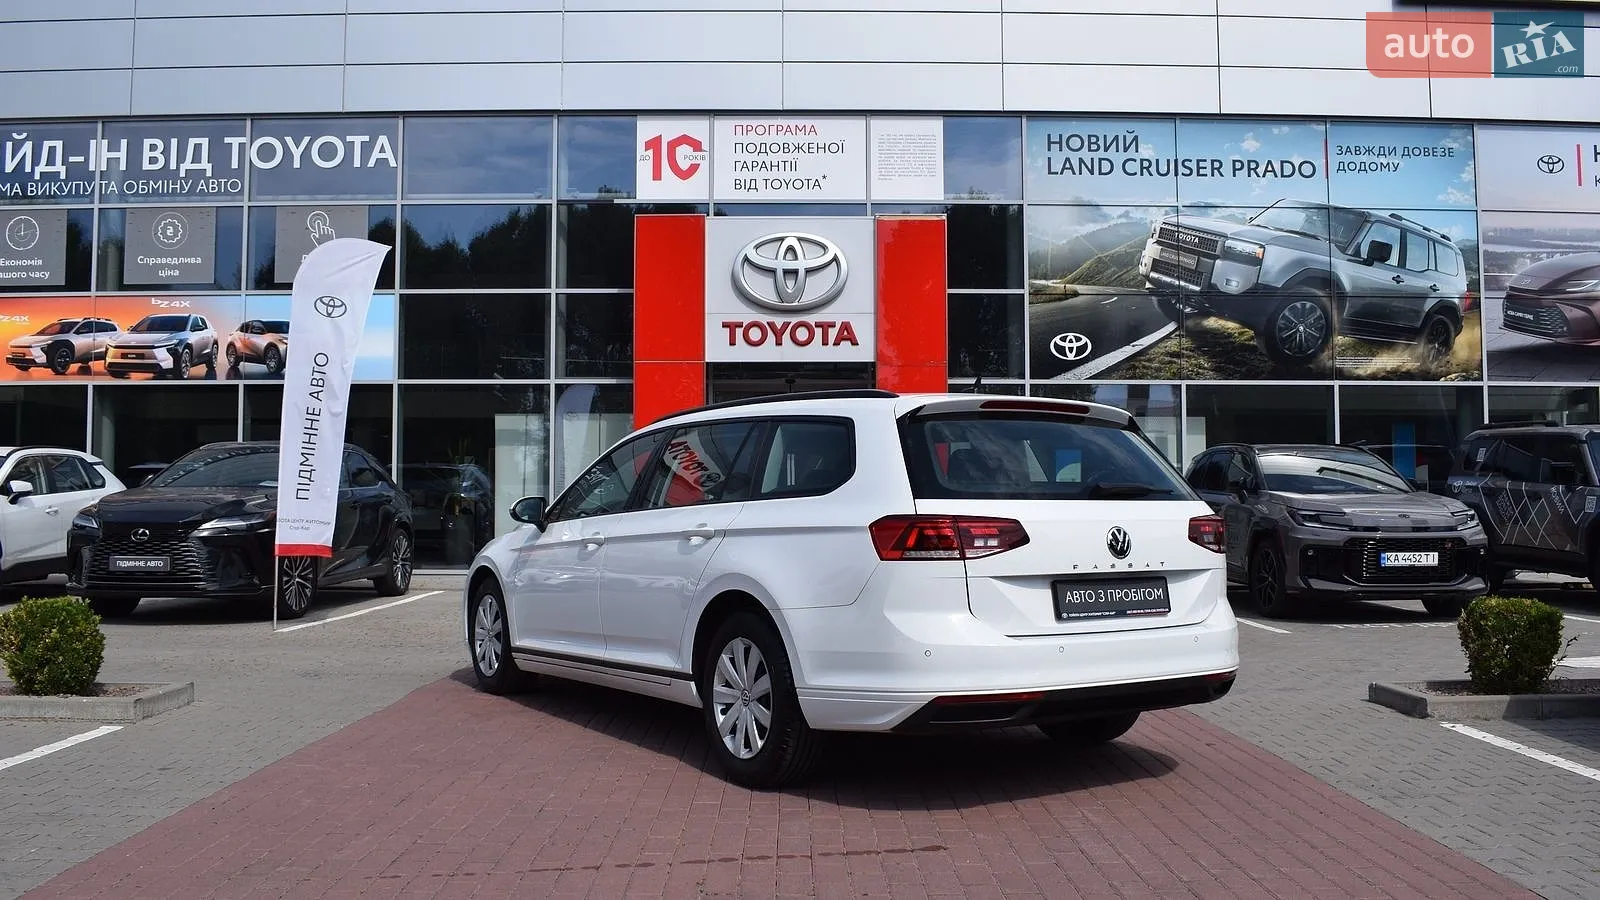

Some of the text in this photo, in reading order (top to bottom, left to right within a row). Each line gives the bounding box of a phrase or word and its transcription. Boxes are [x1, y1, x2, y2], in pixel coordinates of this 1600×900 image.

[734, 124, 818, 136] ПРОГРАМА
[734, 139, 846, 156] ПОДОВЖЕНОЇ
[1047, 130, 1139, 153] НОВИЙ
[142, 138, 212, 177] ВІД
[224, 135, 398, 169] TOYOTA
[639, 154, 651, 162] ДО
[1336, 145, 1455, 159] ЗАВЖДИ ДОВЕЗЕ
[734, 157, 799, 172] ГАРАНТІЇ
[1047, 157, 1317, 178] LAND CRUISER PRADO
[1336, 161, 1400, 173] ДОДОМУ
[27, 181, 96, 196] ВИКУПУ
[99, 181, 119, 194] ТА
[123, 180, 193, 195] ОБМІНУ
[196, 179, 242, 194] АВТО
[734, 178, 759, 192] ВІД
[1175, 232, 1199, 244] TOYOTA
[0, 257, 42, 266] Економія
[137, 255, 202, 265] Справедлива
[28, 271, 50, 280] часу
[158, 267, 180, 277] ціна
[721, 320, 859, 347] TOYOTA
[296, 352, 329, 500] ПІДМІННЕ АВТО
[116, 560, 145, 568] ПІДМІННЕ
[1386, 553, 1400, 563] KA
[1401, 553, 1423, 563] 4452
[1065, 588, 1164, 603] АВТО З ПРОБІГОМ
